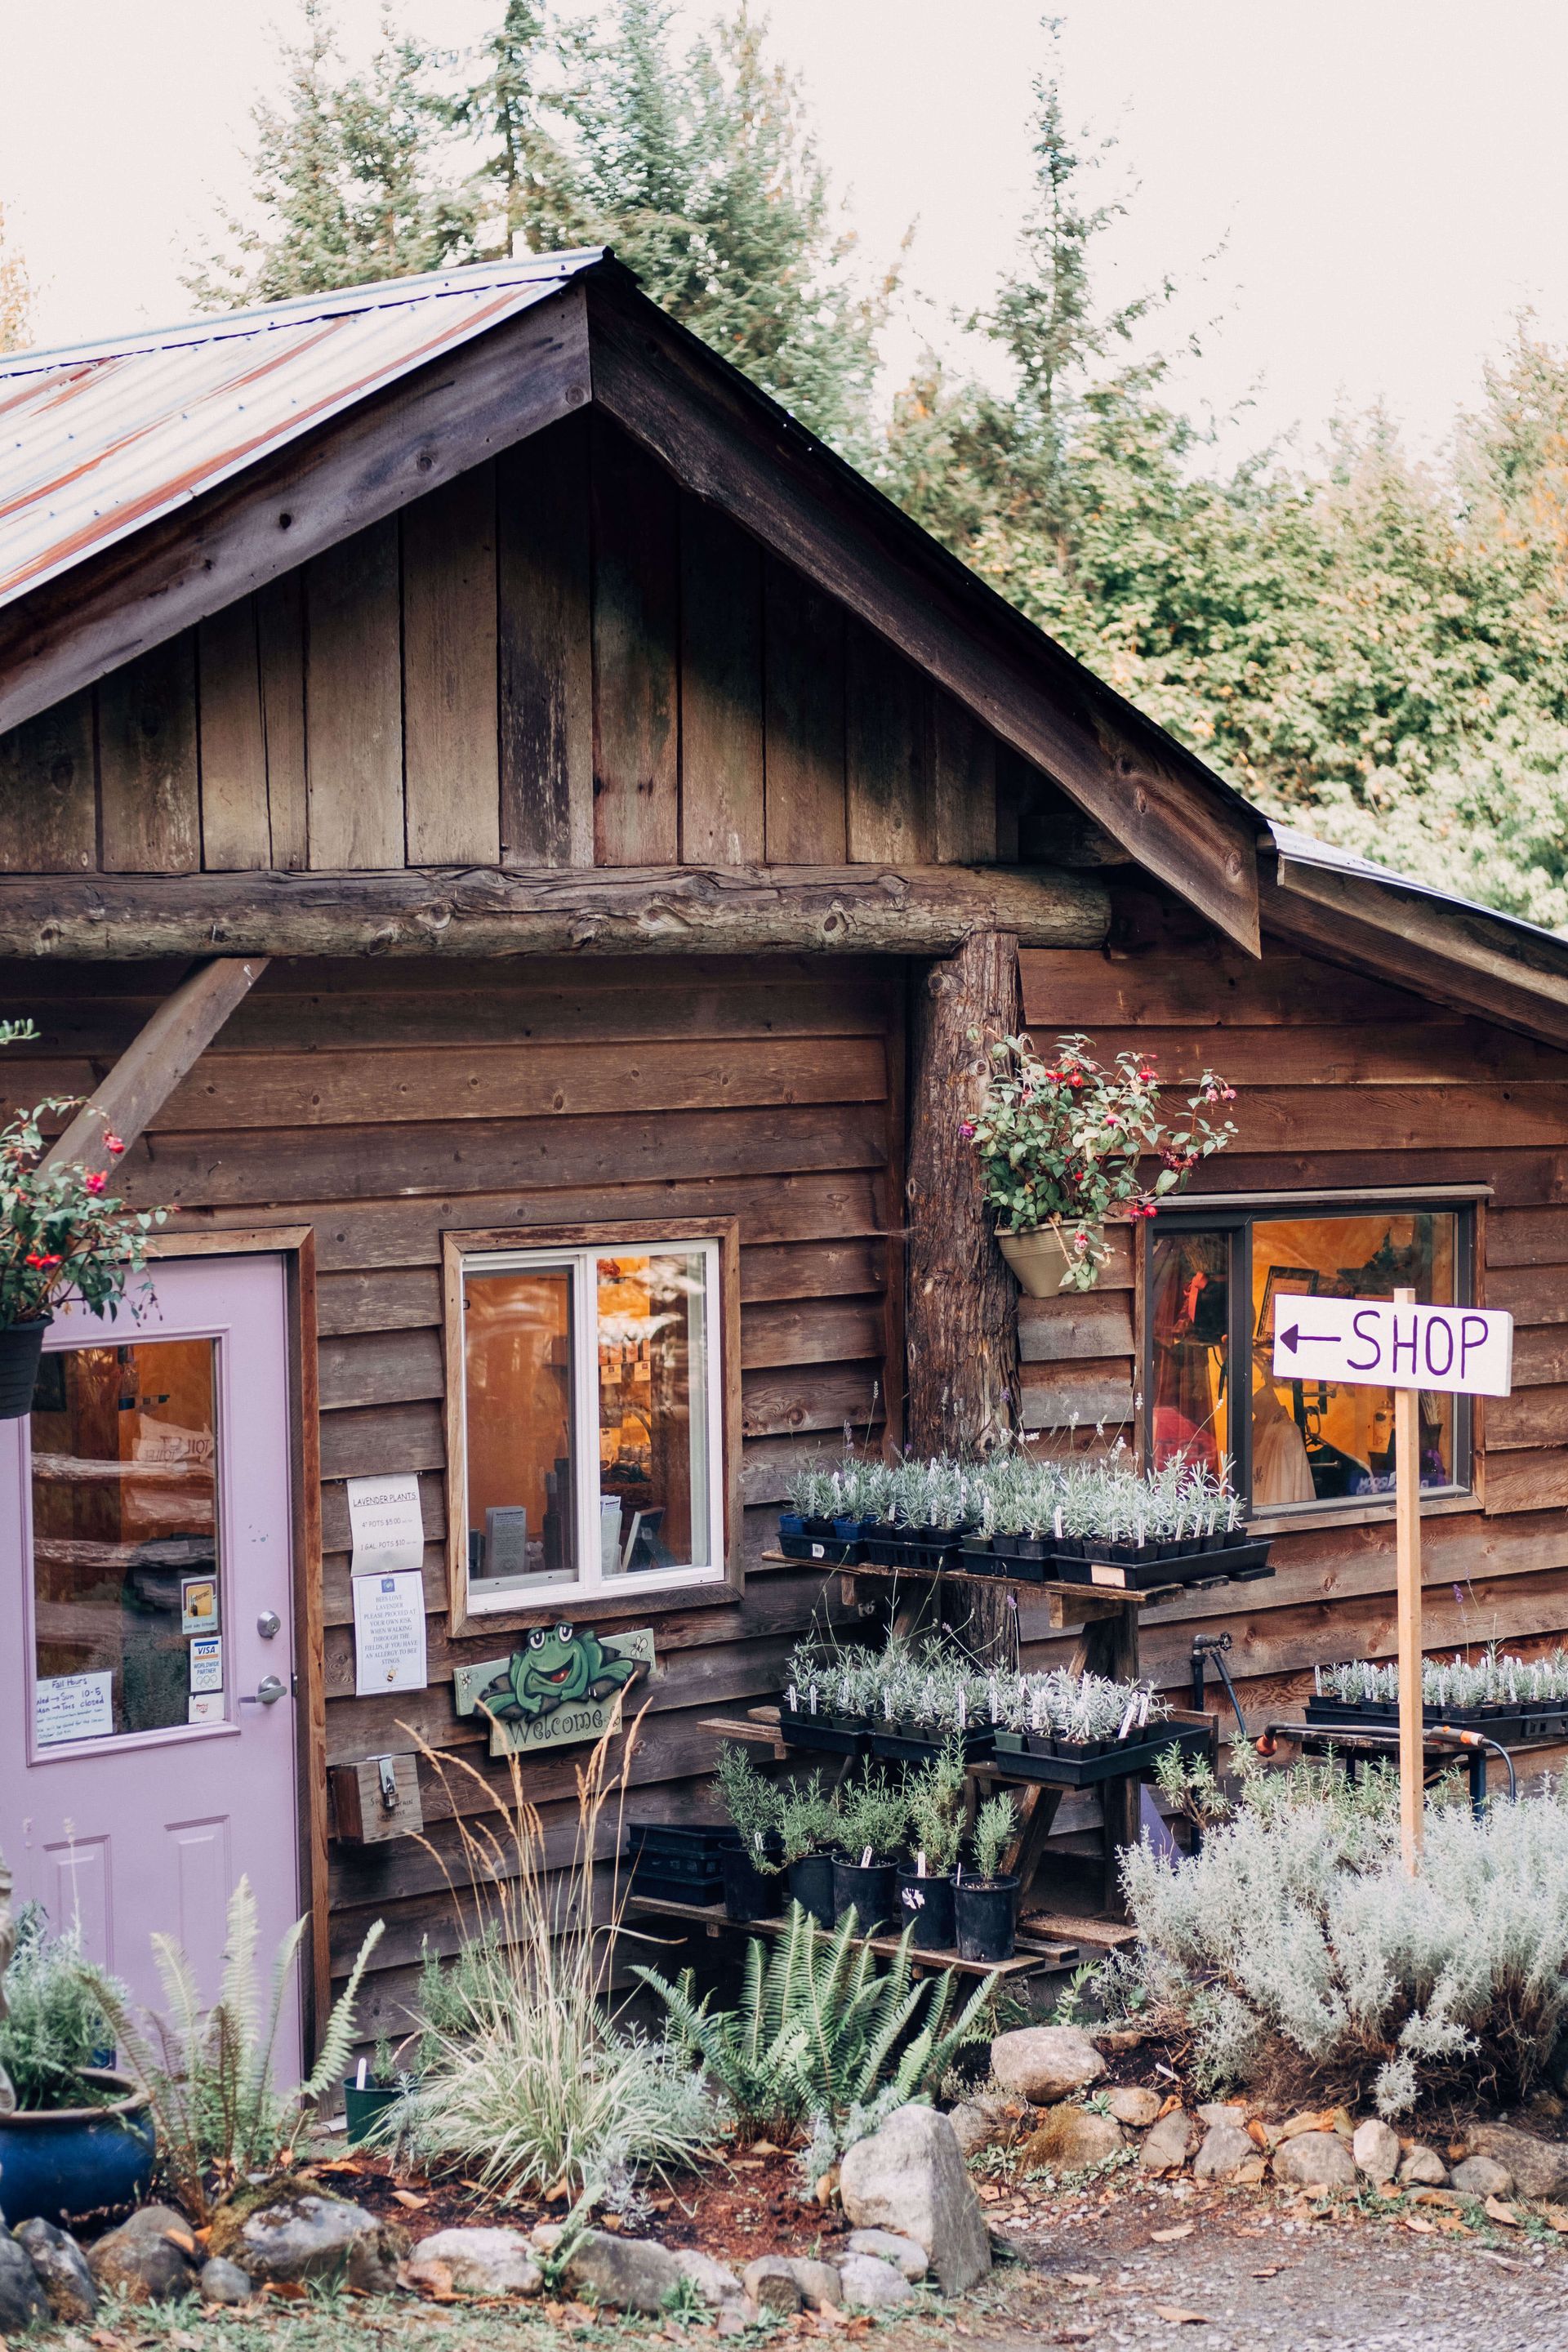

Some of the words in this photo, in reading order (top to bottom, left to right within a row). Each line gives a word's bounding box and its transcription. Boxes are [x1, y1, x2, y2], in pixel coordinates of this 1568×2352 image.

[1347, 1310, 1489, 1379] SHOP
[353, 1495, 388, 1507] LAVENDER
[389, 1492, 416, 1502] PLANTS
[378, 1540, 394, 1548] POTS
[395, 1539, 406, 1547] $10
[376, 1602, 403, 1610] LAVENDER
[198, 1646, 216, 1655] VISA
[375, 1650, 399, 1658] ALLERGY
[194, 1660, 220, 1668] WORLDWIDE
[52, 1680, 65, 1689] Fall
[67, 1677, 87, 1686] Hours
[60, 1692, 74, 1701] Sun
[80, 1695, 104, 1708] closed
[506, 1708, 604, 1744] Welcome
